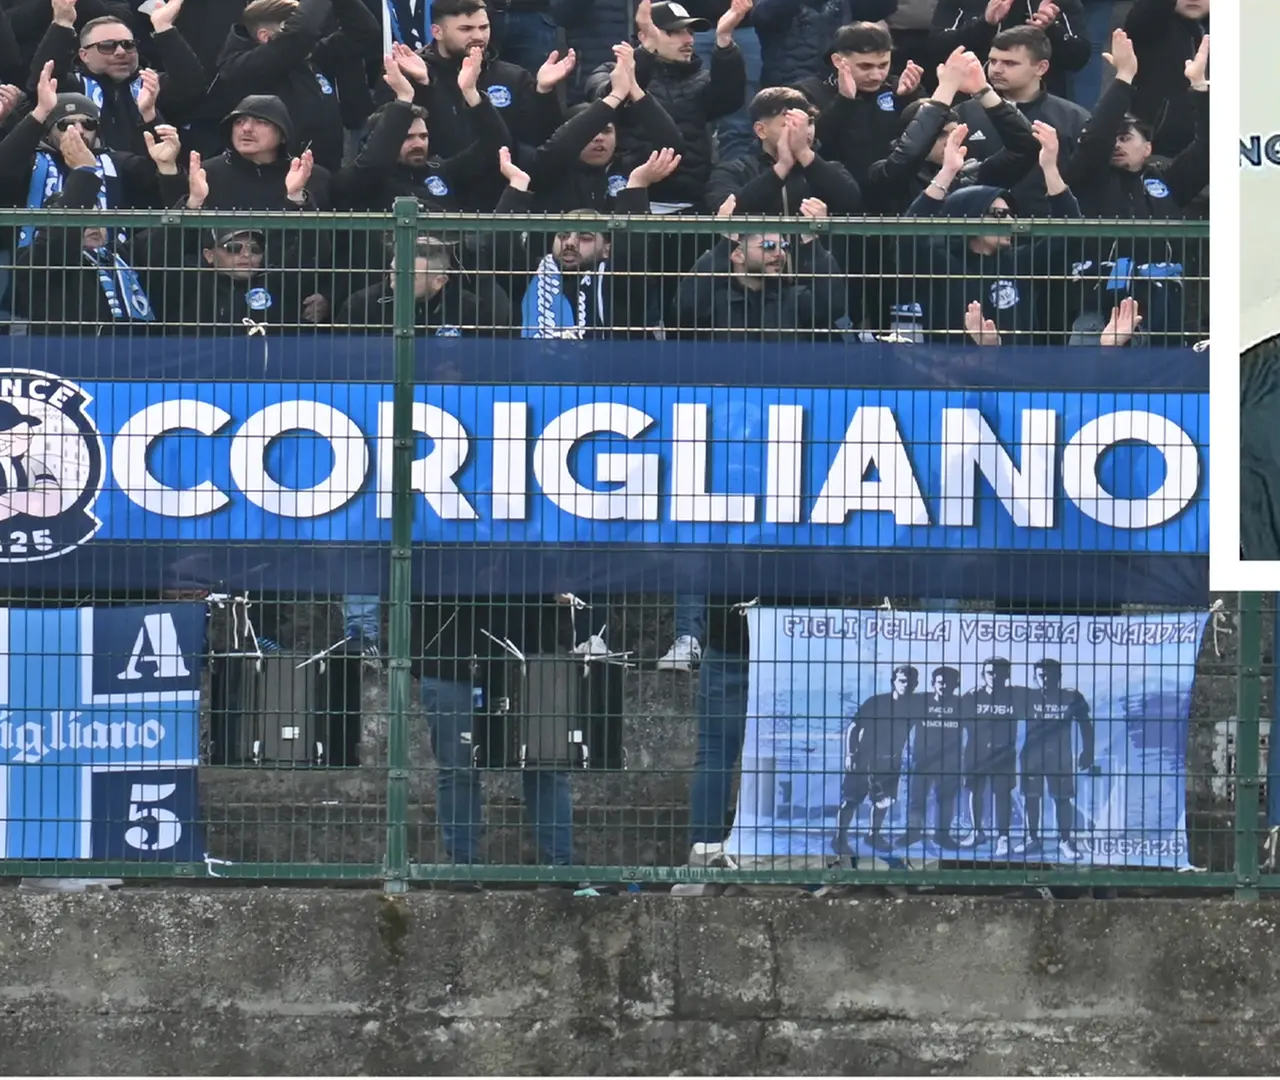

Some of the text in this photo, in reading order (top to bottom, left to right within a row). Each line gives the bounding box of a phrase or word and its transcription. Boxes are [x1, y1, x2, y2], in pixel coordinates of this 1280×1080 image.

[111, 397, 1202, 530] CORIGLIANO
[116, 612, 191, 680] A
[783, 615, 1200, 646] FIGLI DELLA VECCHIA GUARDIA
[124, 782, 183, 850] 5
